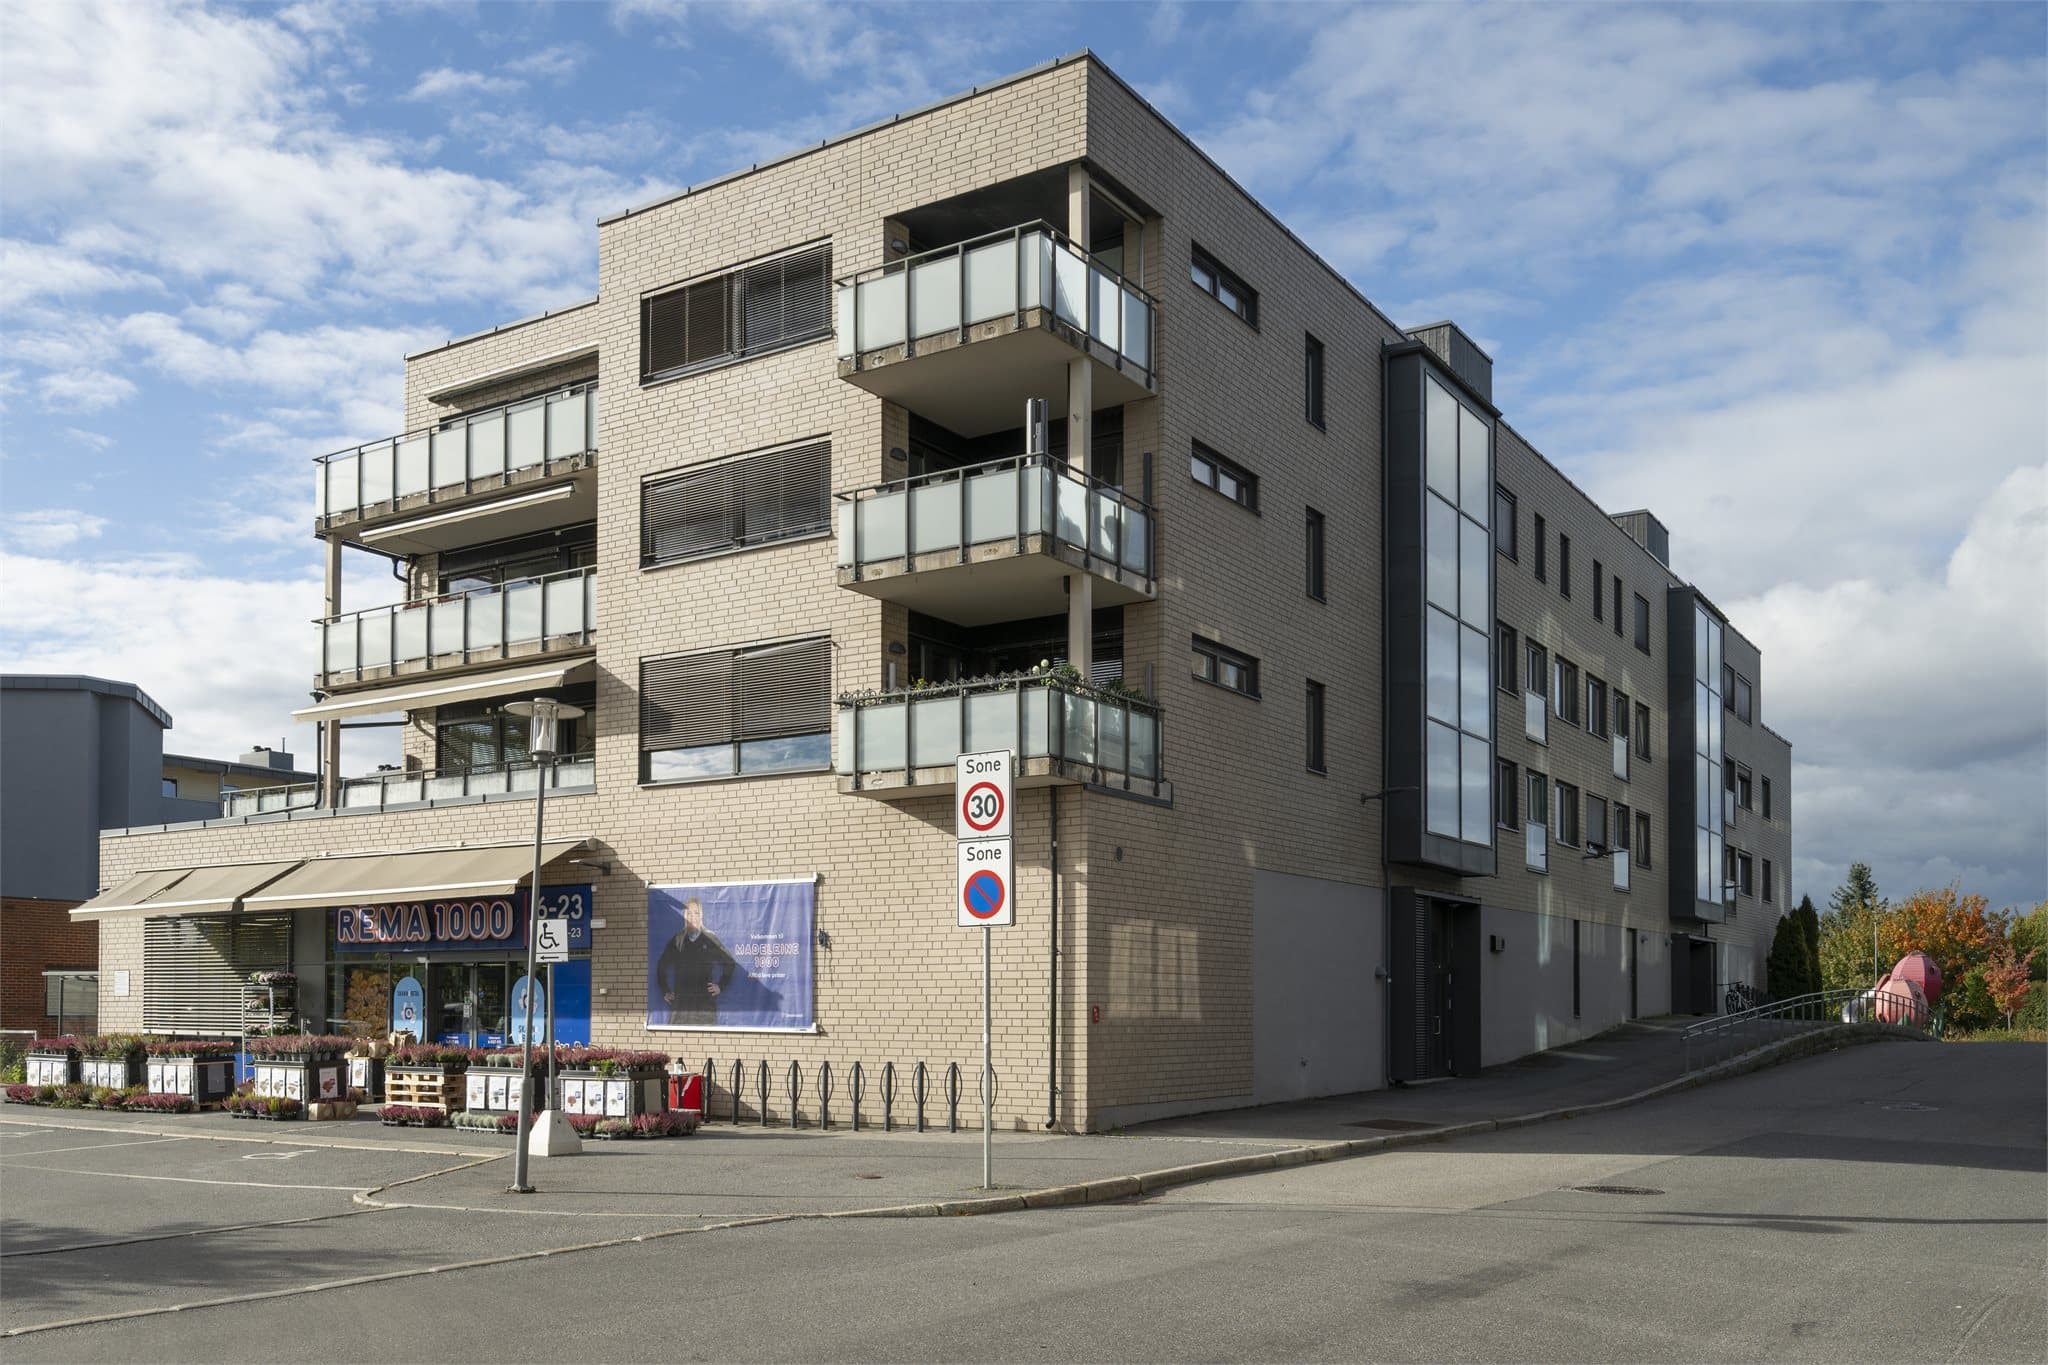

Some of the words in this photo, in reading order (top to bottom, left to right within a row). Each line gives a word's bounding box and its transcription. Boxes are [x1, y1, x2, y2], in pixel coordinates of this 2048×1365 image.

[966, 759, 1001, 774] Sone
[970, 793, 997, 819] 30
[966, 846, 1002, 862] Sone
[538, 894, 583, 920] 6-23
[337, 903, 430, 943] REMA
[434, 899, 514, 941] 1000
[735, 942, 800, 956] MADELEINE
[754, 956, 780, 968] 1000
